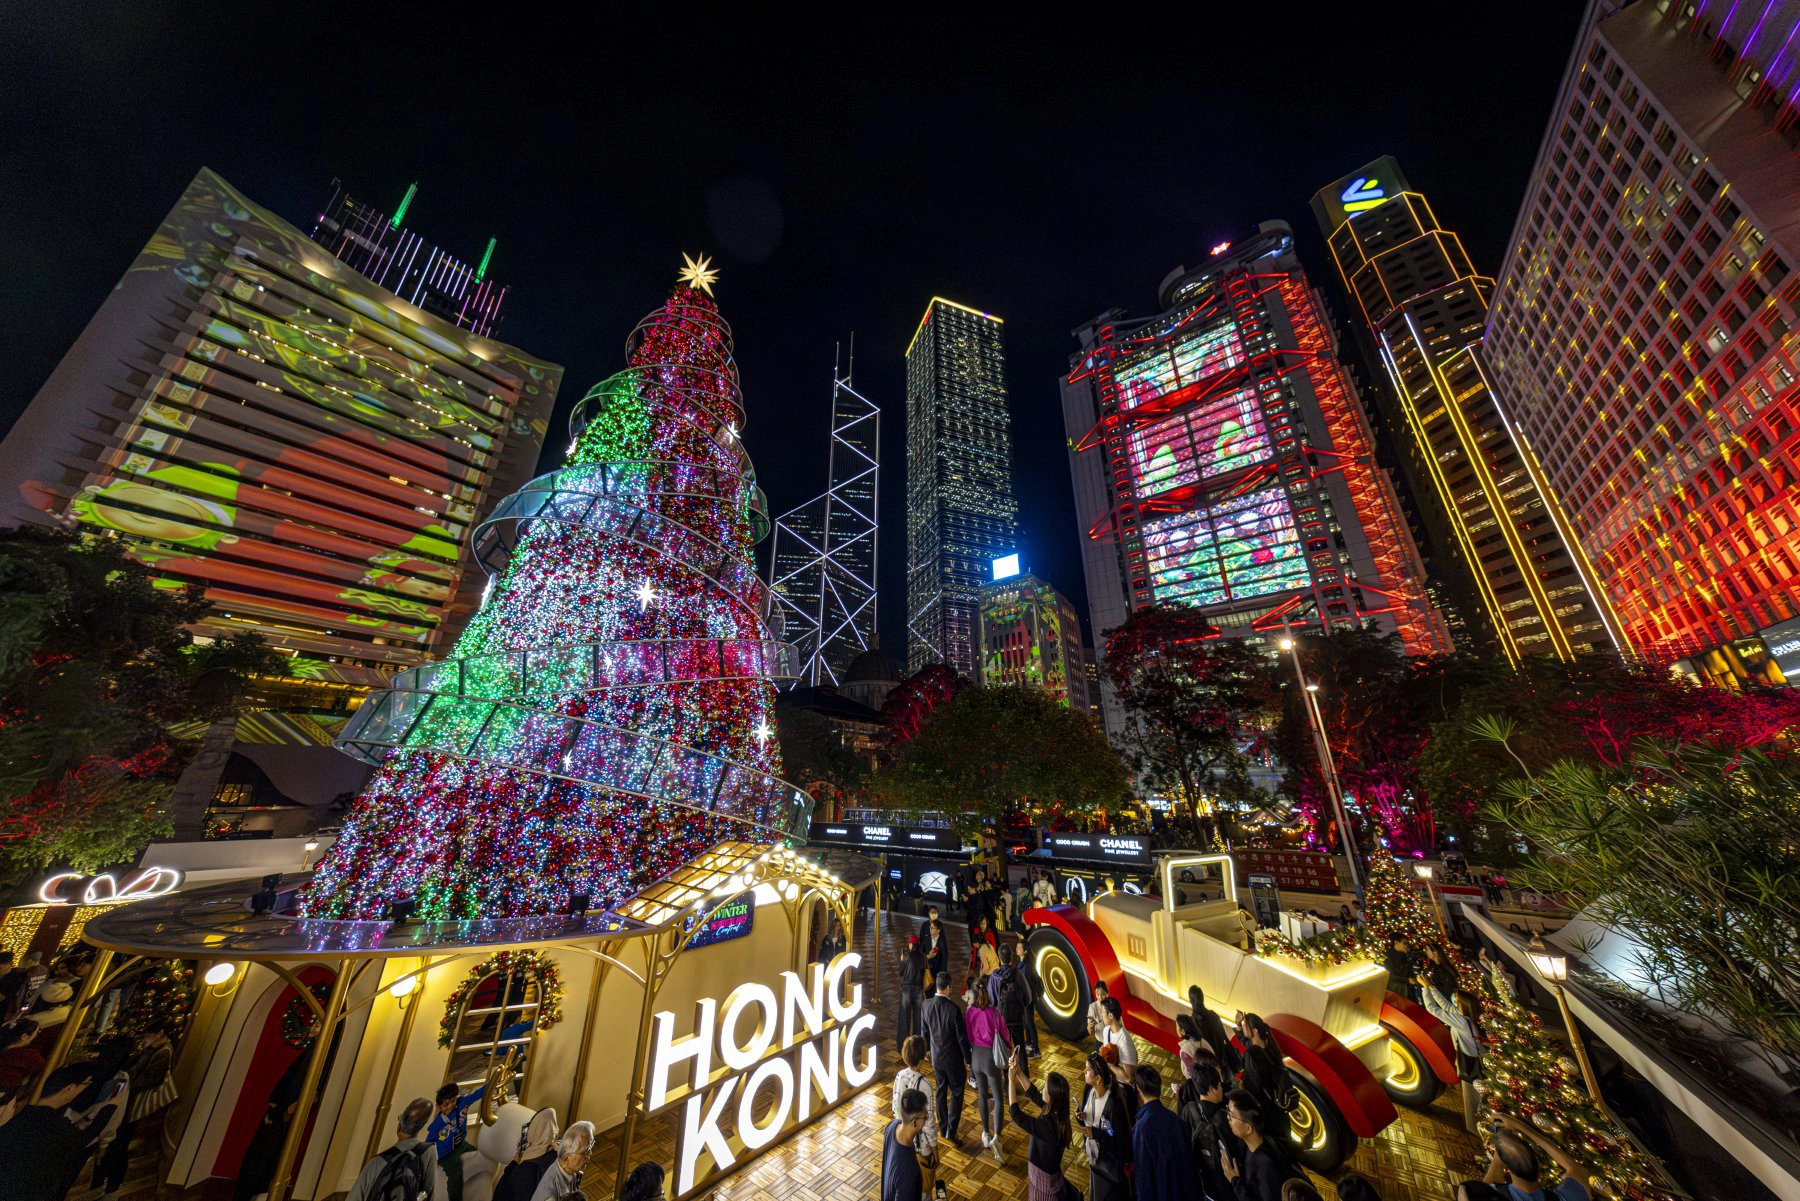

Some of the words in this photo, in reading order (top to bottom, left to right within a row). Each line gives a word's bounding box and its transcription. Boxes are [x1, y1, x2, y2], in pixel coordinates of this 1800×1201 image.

[863, 826, 892, 836] CHANEL
[1099, 838, 1143, 850] CHANEL
[713, 904, 748, 921] WINTER
[648, 952, 863, 1112] HONG
[677, 1013, 878, 1198] KONG
